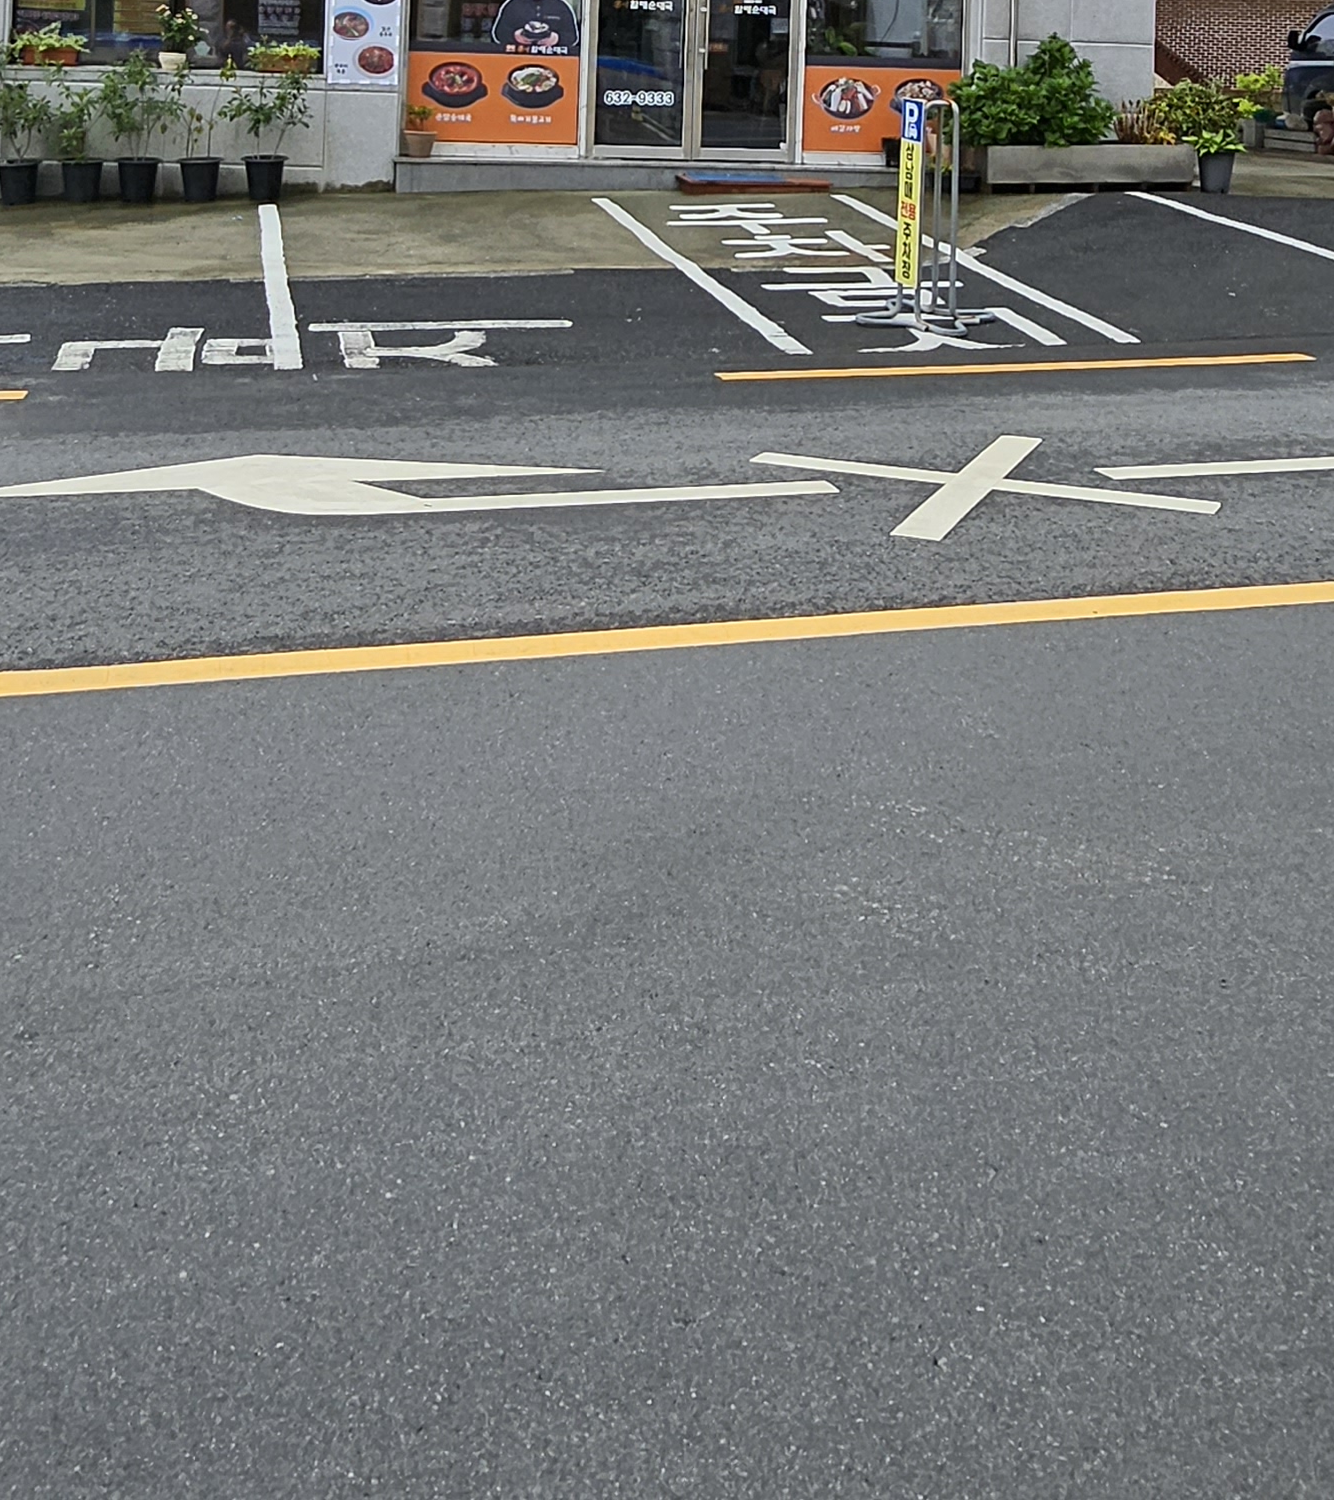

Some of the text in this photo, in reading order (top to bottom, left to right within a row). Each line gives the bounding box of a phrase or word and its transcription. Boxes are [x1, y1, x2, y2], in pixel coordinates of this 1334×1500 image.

[604, 90, 674, 106] 632-9333
[900, 201, 916, 220] 전용
[901, 221, 912, 279] 주차장
